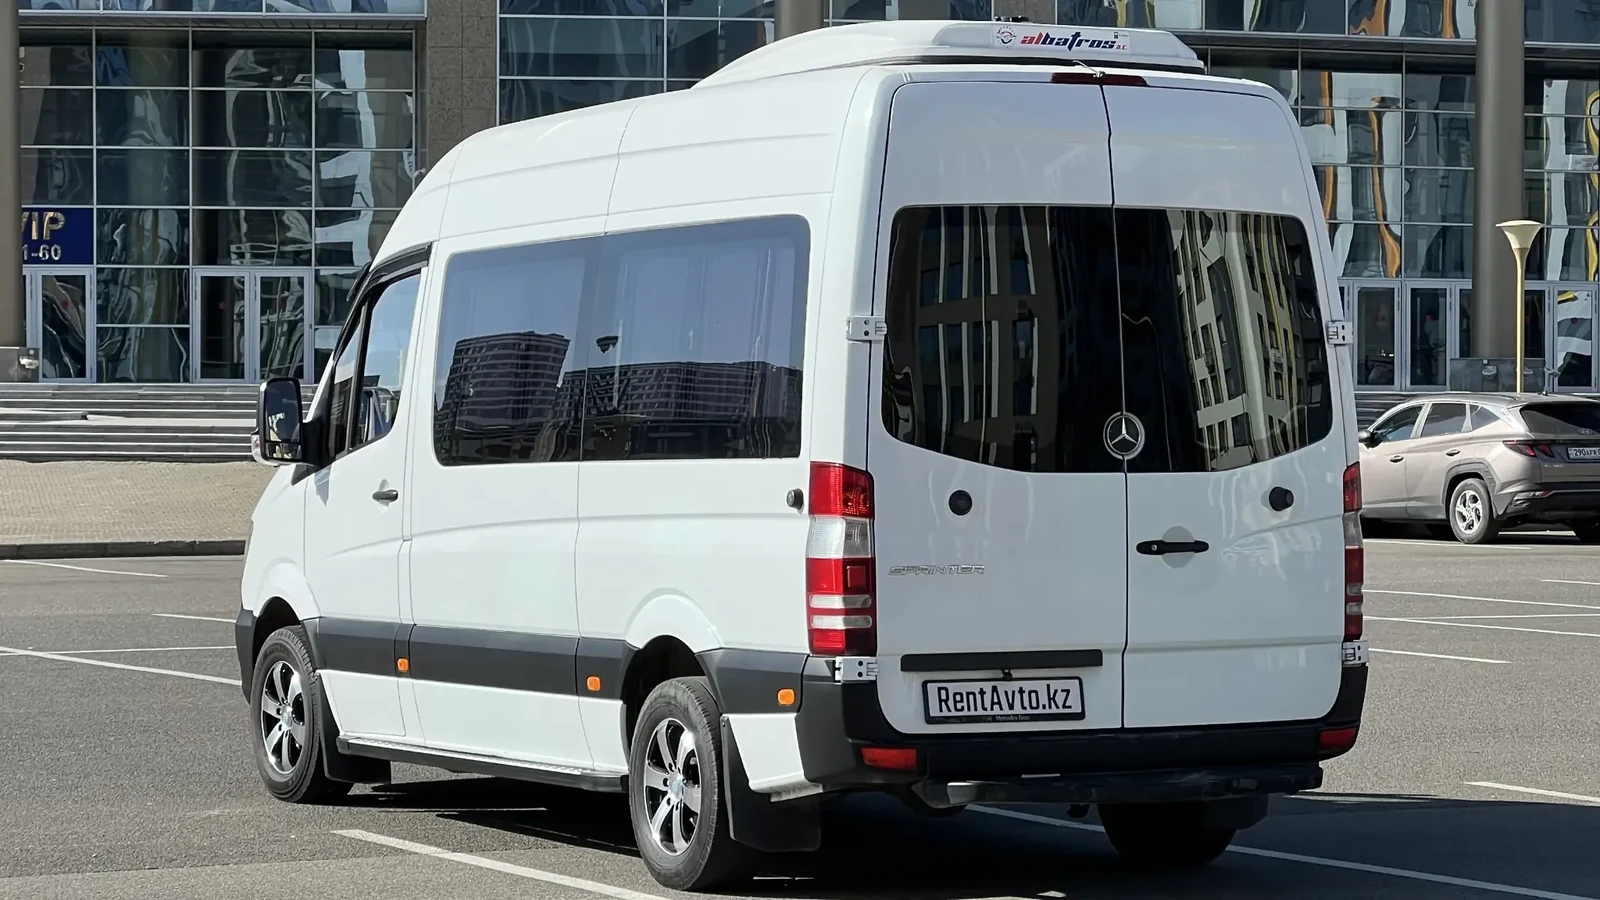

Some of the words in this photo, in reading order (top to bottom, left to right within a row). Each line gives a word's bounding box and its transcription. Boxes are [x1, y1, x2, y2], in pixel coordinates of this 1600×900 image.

[1020, 31, 1117, 52] albatros
[888, 564, 986, 576] SPRINTER
[936, 682, 1073, 713] RentAvto.kz
